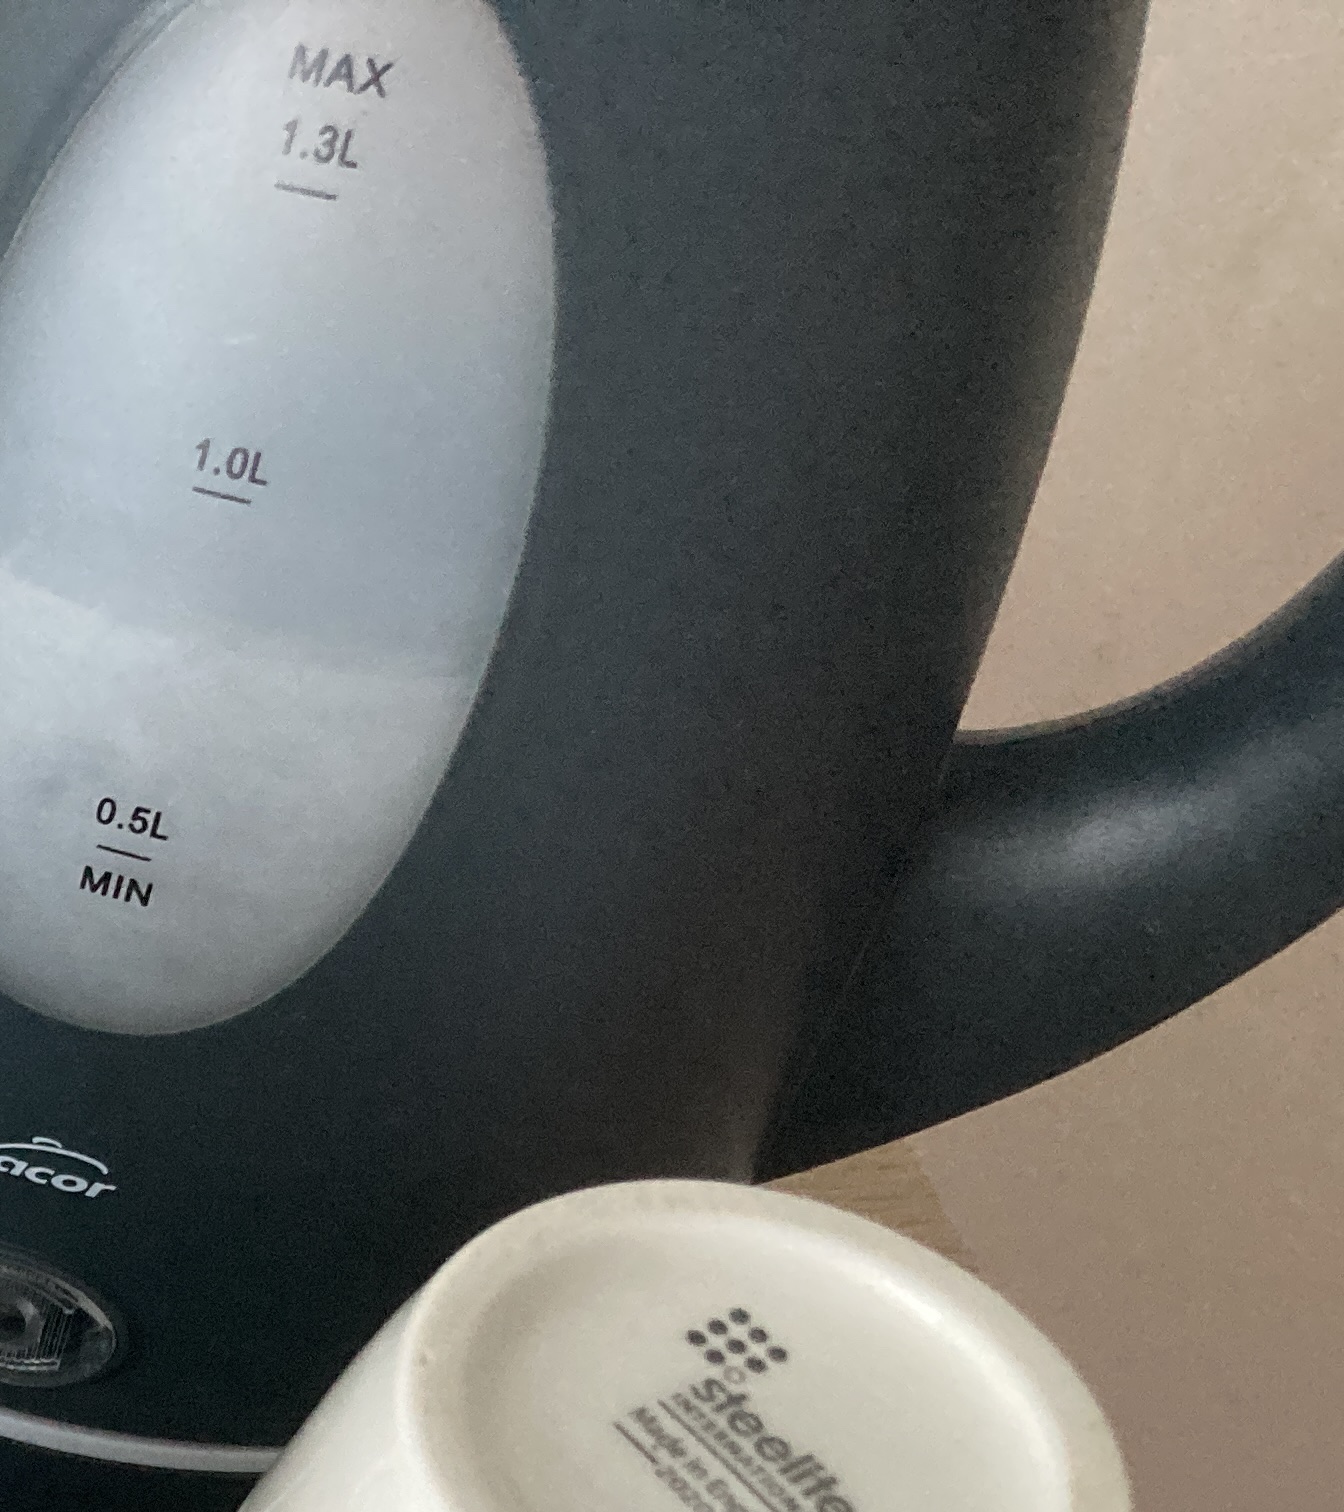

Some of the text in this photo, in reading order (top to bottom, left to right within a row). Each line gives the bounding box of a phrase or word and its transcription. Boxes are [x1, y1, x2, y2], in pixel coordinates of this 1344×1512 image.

[288, 42, 395, 98] MAX
[280, 119, 358, 168] 1.3L
[195, 437, 267, 486] 1.0L
[96, 797, 170, 841] 0.5L
[79, 865, 153, 907] MIN
